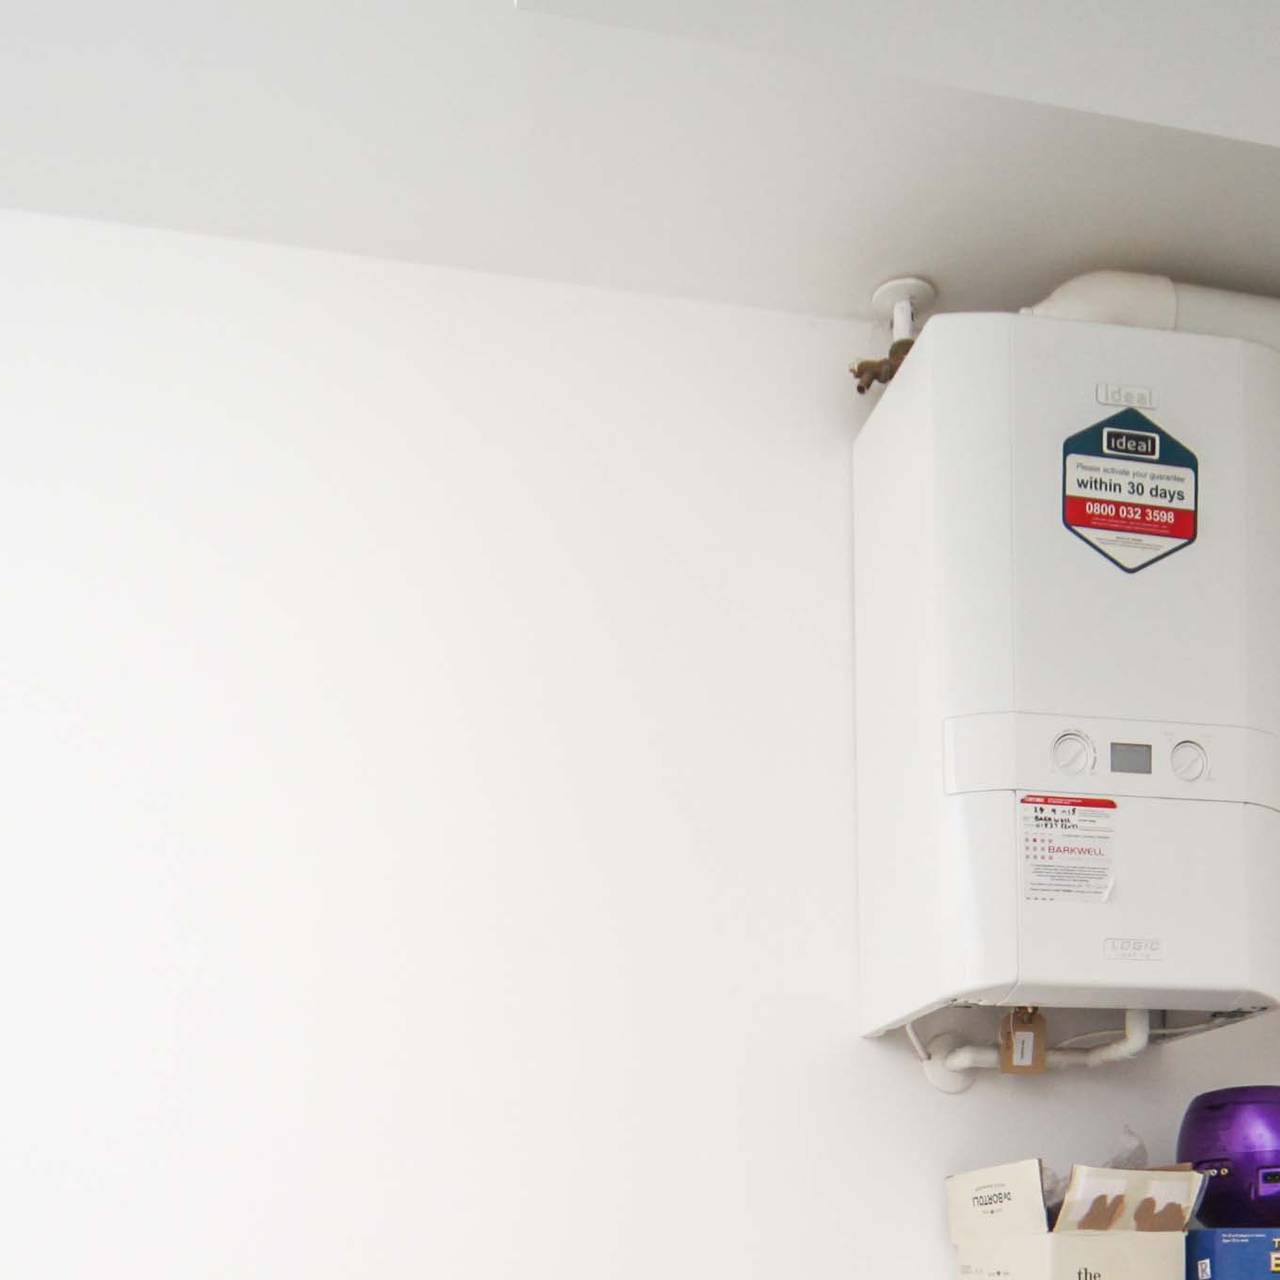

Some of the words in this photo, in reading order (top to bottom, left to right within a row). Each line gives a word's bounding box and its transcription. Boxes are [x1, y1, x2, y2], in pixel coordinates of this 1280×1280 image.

[1110, 434, 1152, 453] ideal
[1076, 476, 1122, 494] within
[1127, 480, 1145, 496] 30
[1149, 484, 1185, 503] days
[1086, 502, 1116, 517] 0800
[1119, 506, 1142, 520] 032
[1145, 508, 1175, 524] 3598
[1048, 845, 1104, 857] BARKWELL
